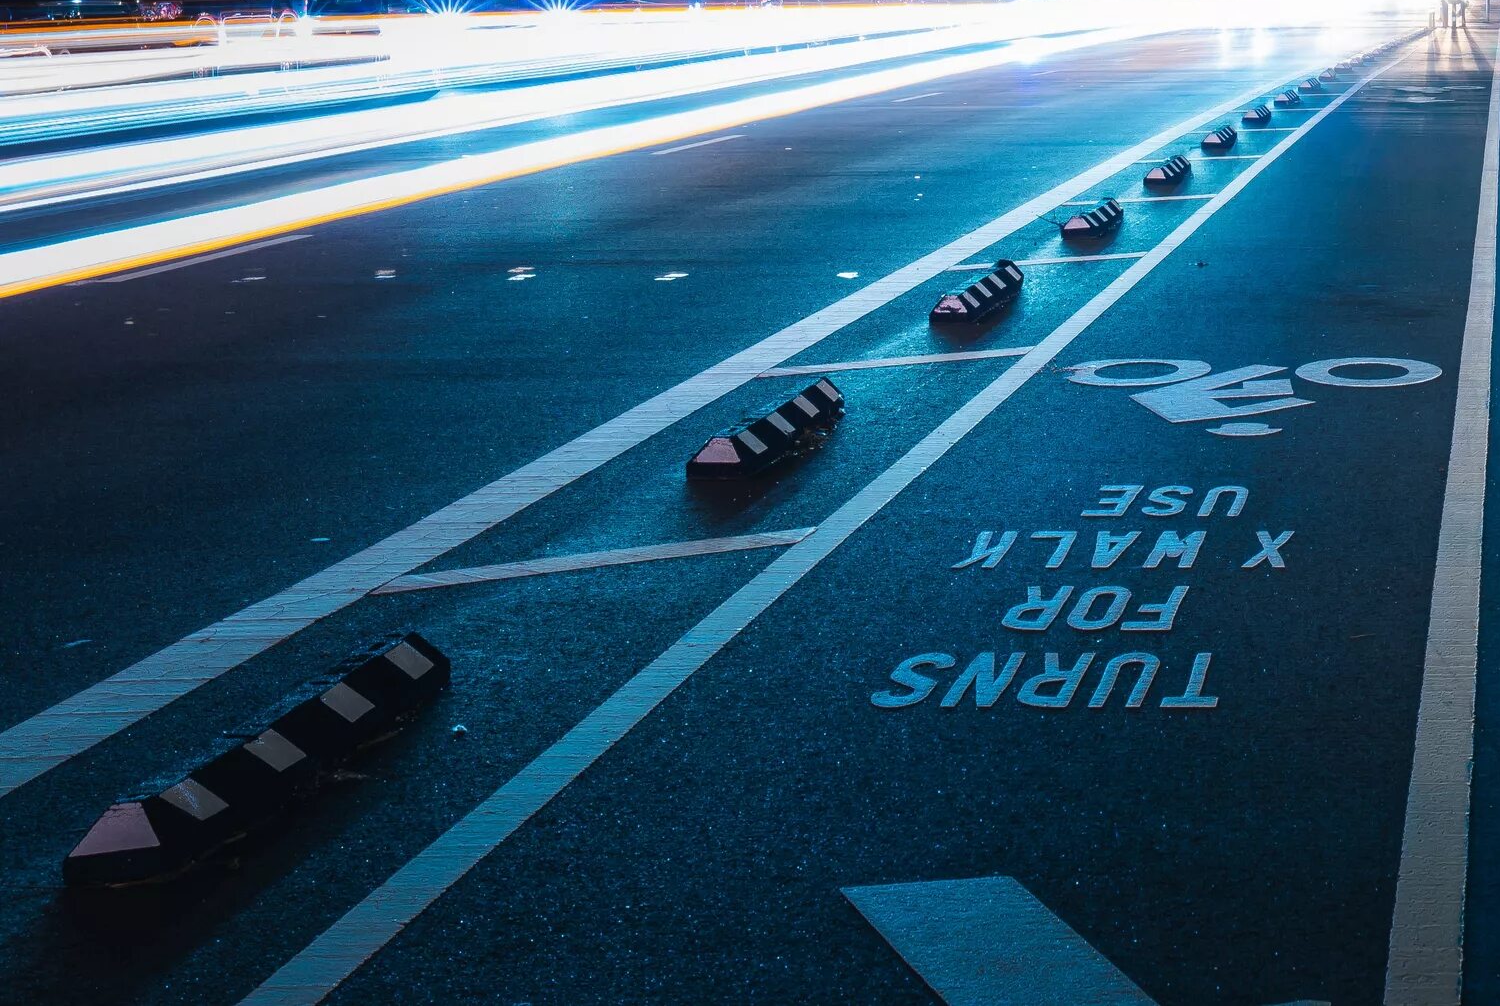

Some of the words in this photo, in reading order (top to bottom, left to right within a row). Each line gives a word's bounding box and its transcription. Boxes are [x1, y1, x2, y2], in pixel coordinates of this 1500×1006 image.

[1081, 483, 1249, 517] USE
[952, 529, 1206, 568] WALK
[1241, 529, 1294, 568] X
[1001, 585, 1189, 631] FOR
[871, 651, 1218, 708] TURNS
